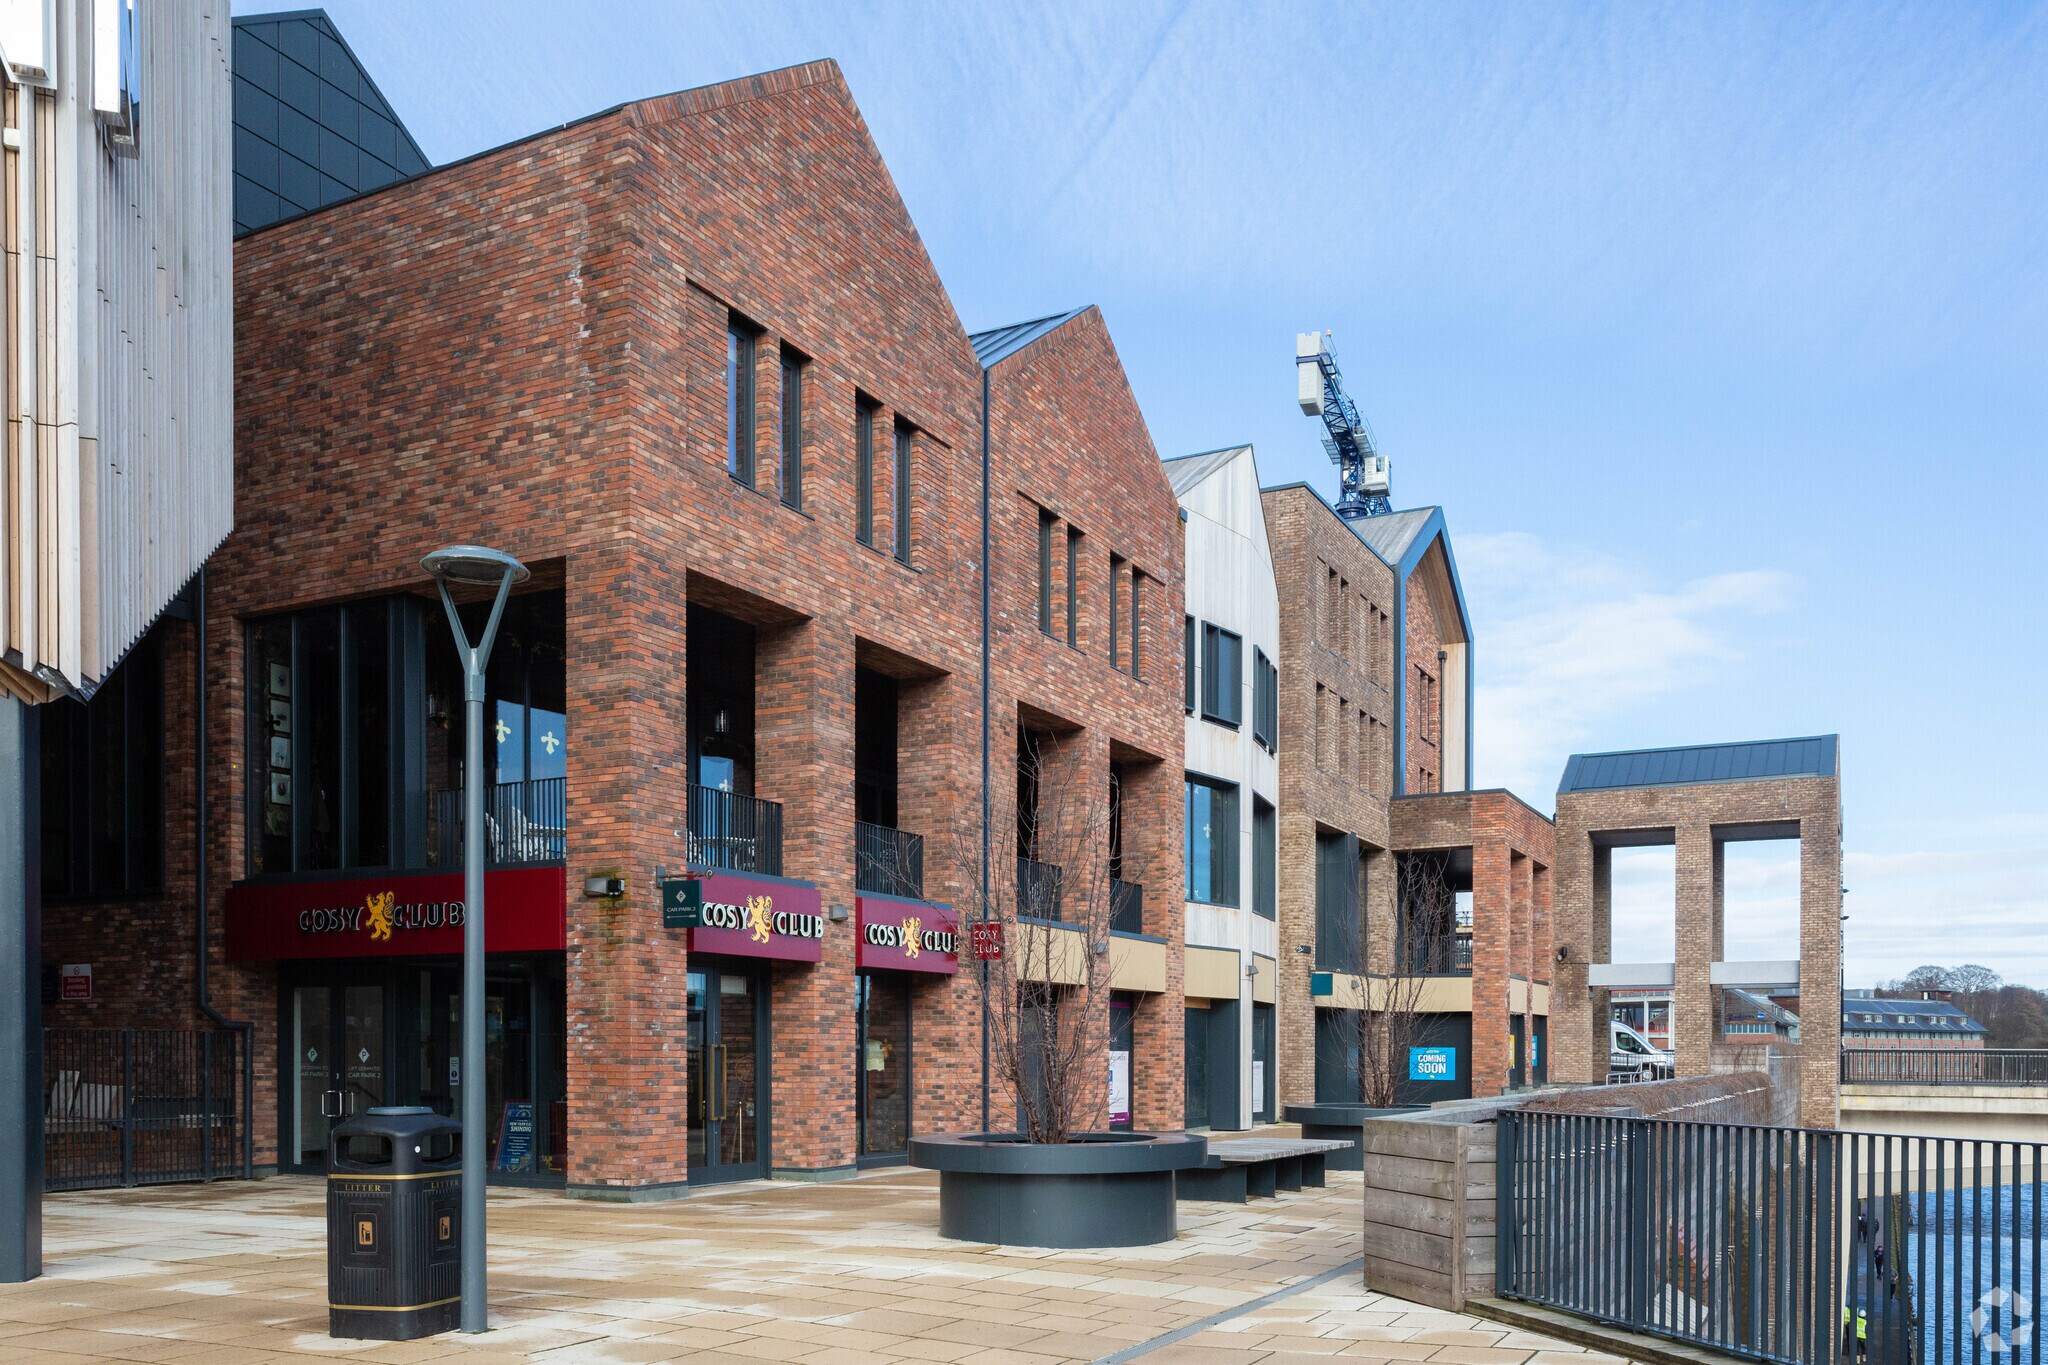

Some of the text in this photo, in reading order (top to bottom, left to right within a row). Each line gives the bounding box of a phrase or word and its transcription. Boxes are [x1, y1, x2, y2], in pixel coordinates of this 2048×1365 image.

[300, 902, 465, 931] COSY CLUB
[702, 901, 824, 938] COSY CLUB
[866, 923, 905, 947] COSY
[1418, 1054, 1446, 1063] COMING
[1418, 1063, 1447, 1074] SOON
[345, 1184, 381, 1192] LITTER
[431, 1179, 460, 1189] LITTER
